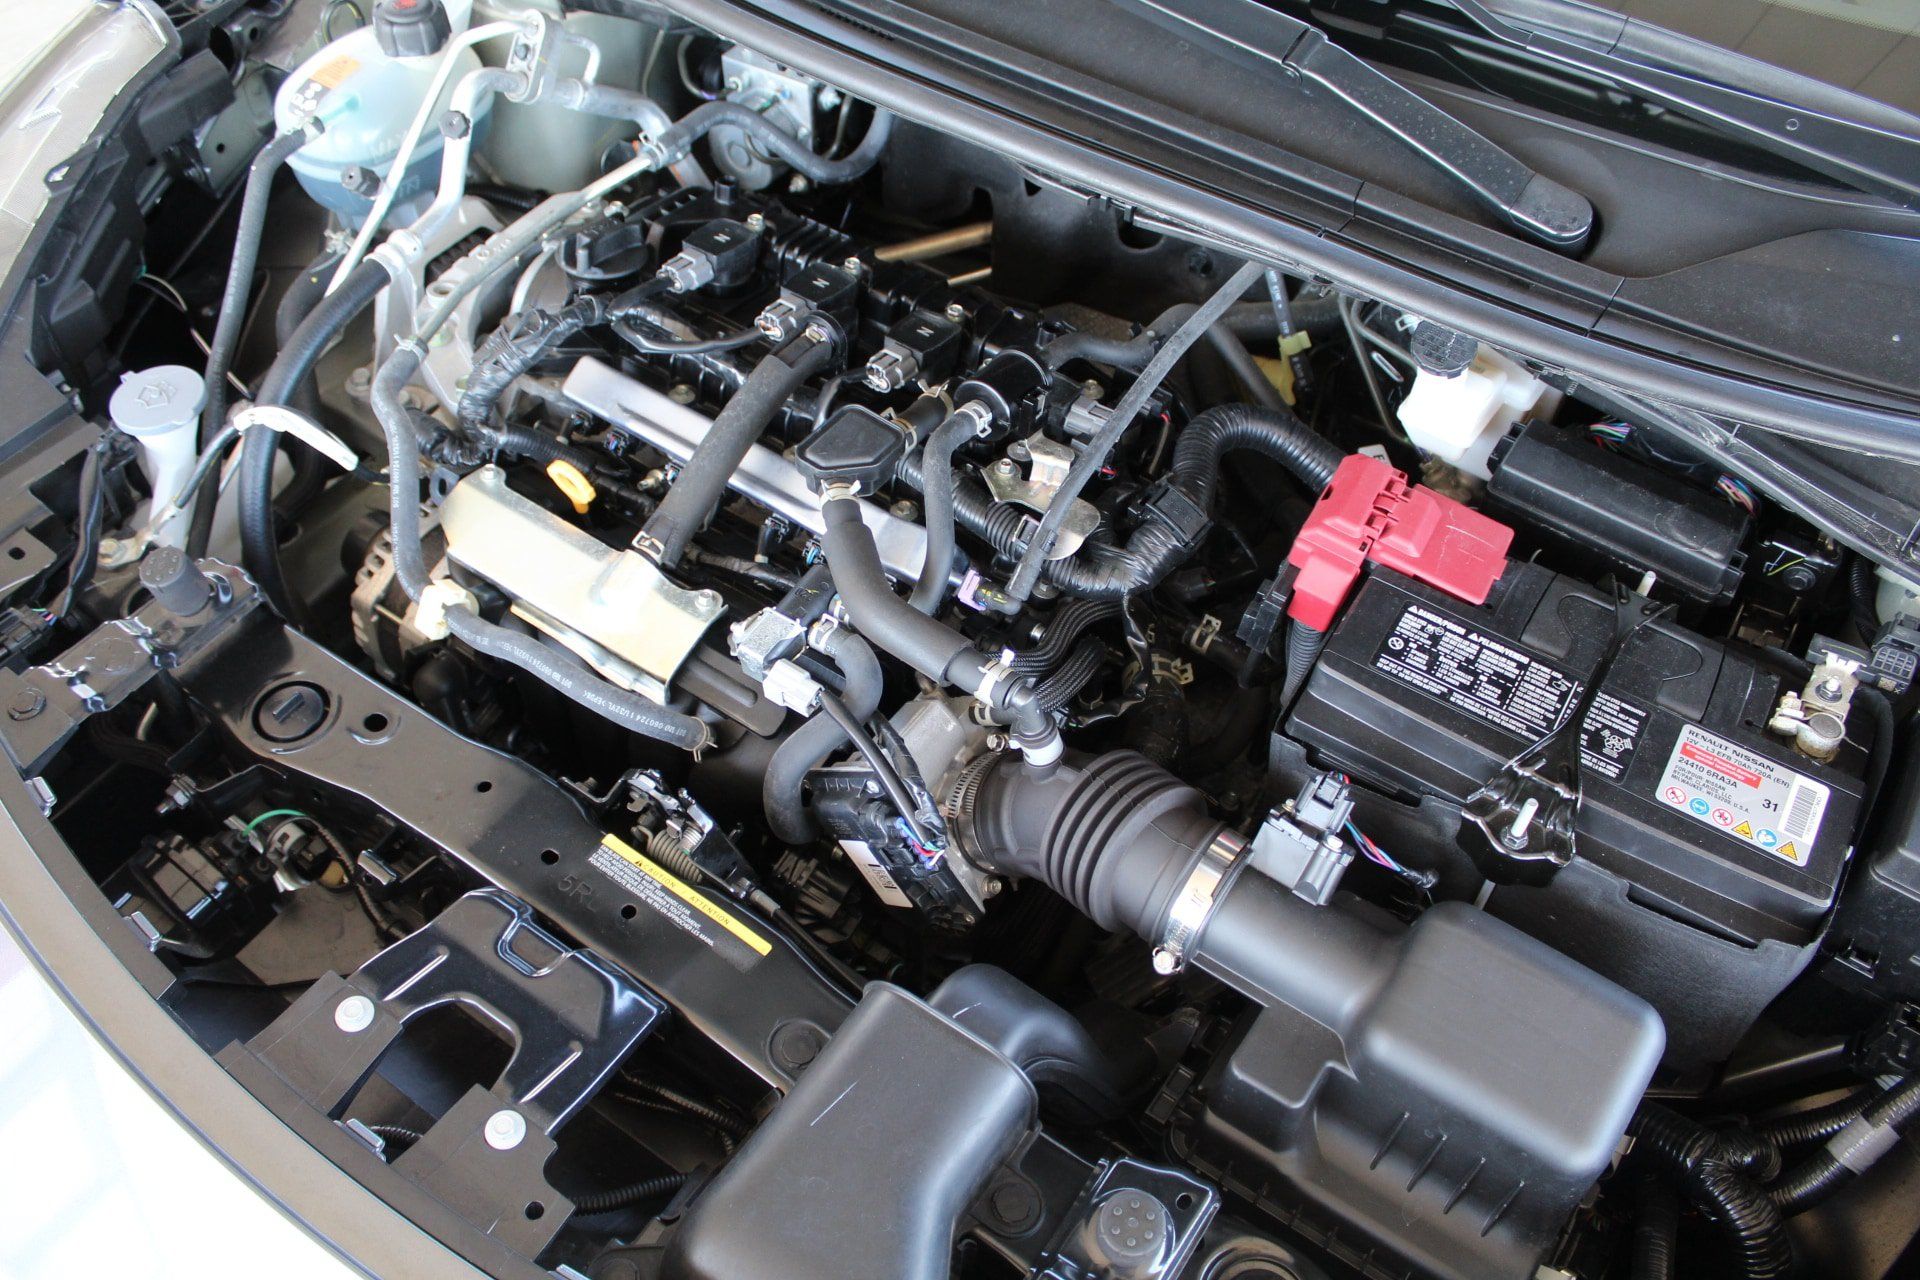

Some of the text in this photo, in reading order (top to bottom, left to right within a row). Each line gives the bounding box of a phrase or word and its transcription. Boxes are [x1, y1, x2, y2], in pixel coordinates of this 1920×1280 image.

[1416, 608, 1466, 635] DANGER/POISON
[1477, 636, 1530, 664] PELIGRO/VENENO
[1685, 736, 1789, 788] 12V L3 EFB 70Ah 720A (EN)
[1688, 729, 1774, 773] RENAULT NISSAN
[1677, 755, 1738, 789] 24410 6RA3A
[1704, 778, 1726, 791] NISSAN
[1721, 791, 1732, 800] LLC
[1761, 797, 1778, 812] 31
[643, 863, 676, 889] CAUTION
[689, 895, 731, 926] ATTENTION
